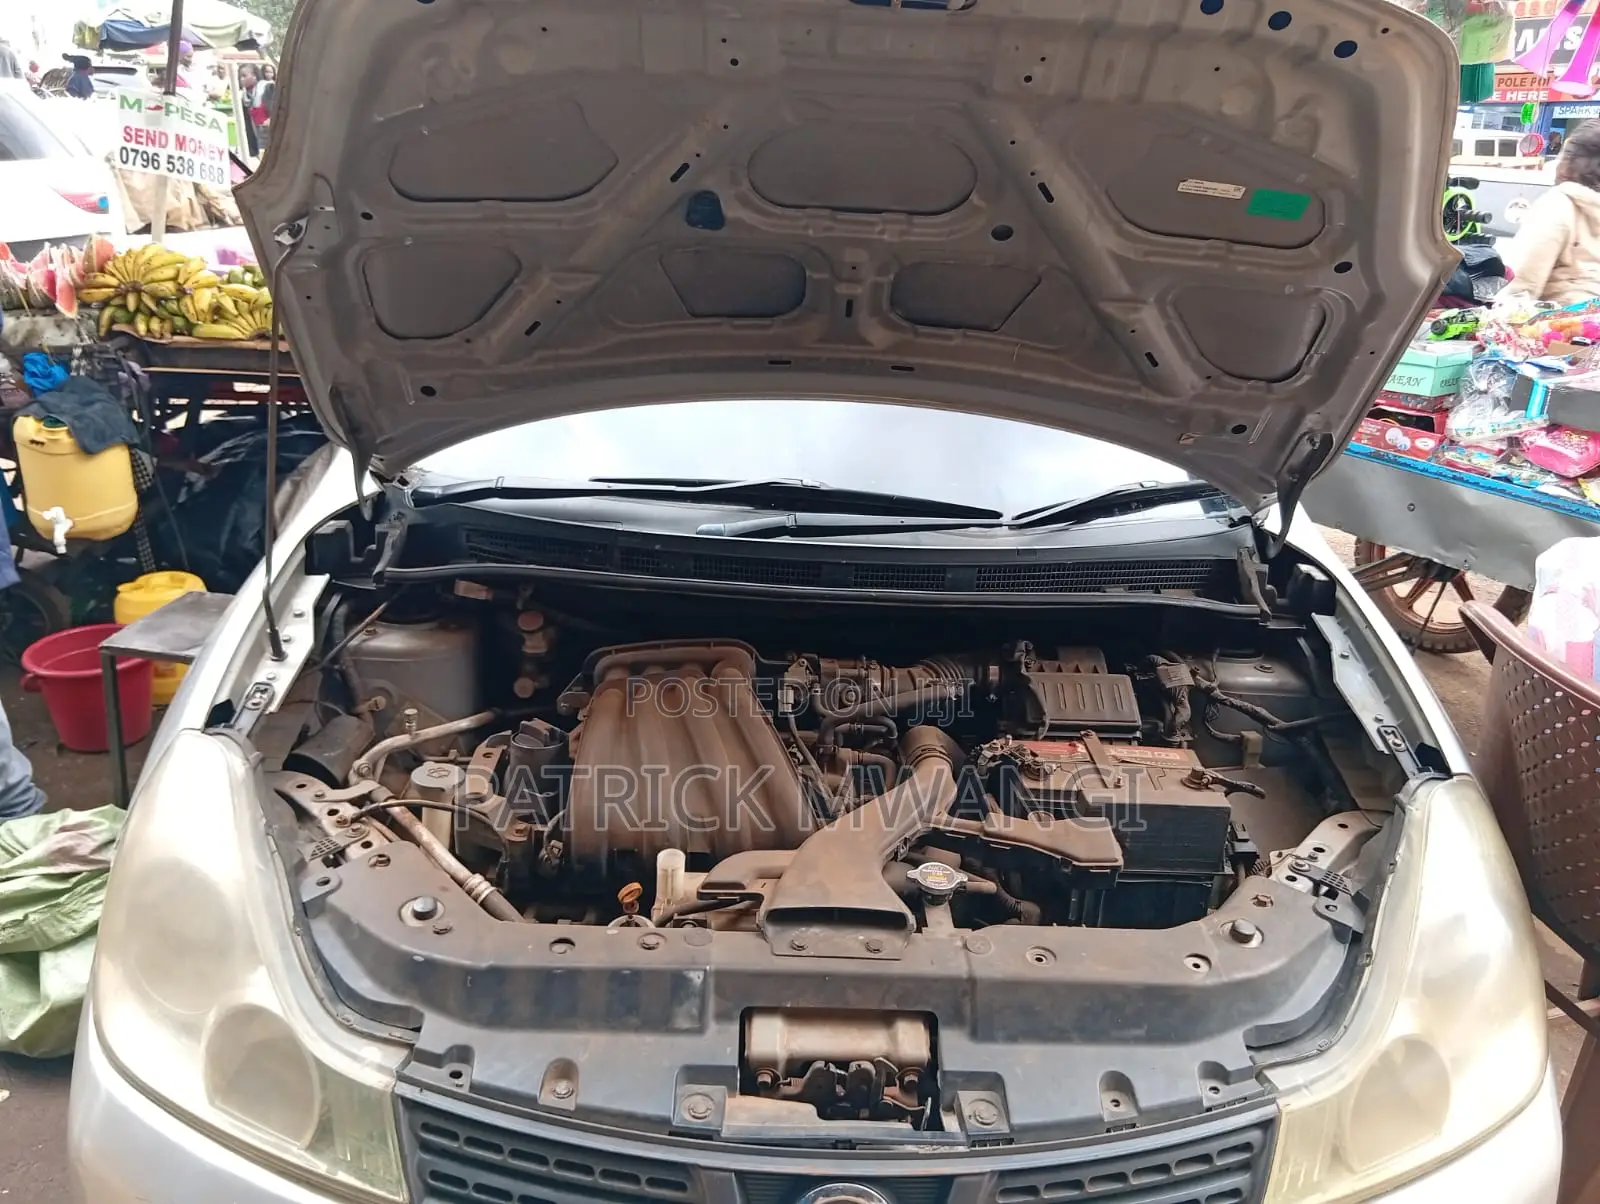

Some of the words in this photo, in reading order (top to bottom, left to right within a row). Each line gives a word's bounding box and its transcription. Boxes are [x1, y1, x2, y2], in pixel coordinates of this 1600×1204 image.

[1497, 77, 1528, 87] POLE
[1504, 90, 1549, 101] HERE
[119, 94, 223, 133] M-PESA
[123, 125, 169, 149] SEND
[175, 133, 224, 162] MONEY
[119, 146, 161, 171] 0796
[166, 154, 195, 178] 538
[199, 162, 225, 185] 688
